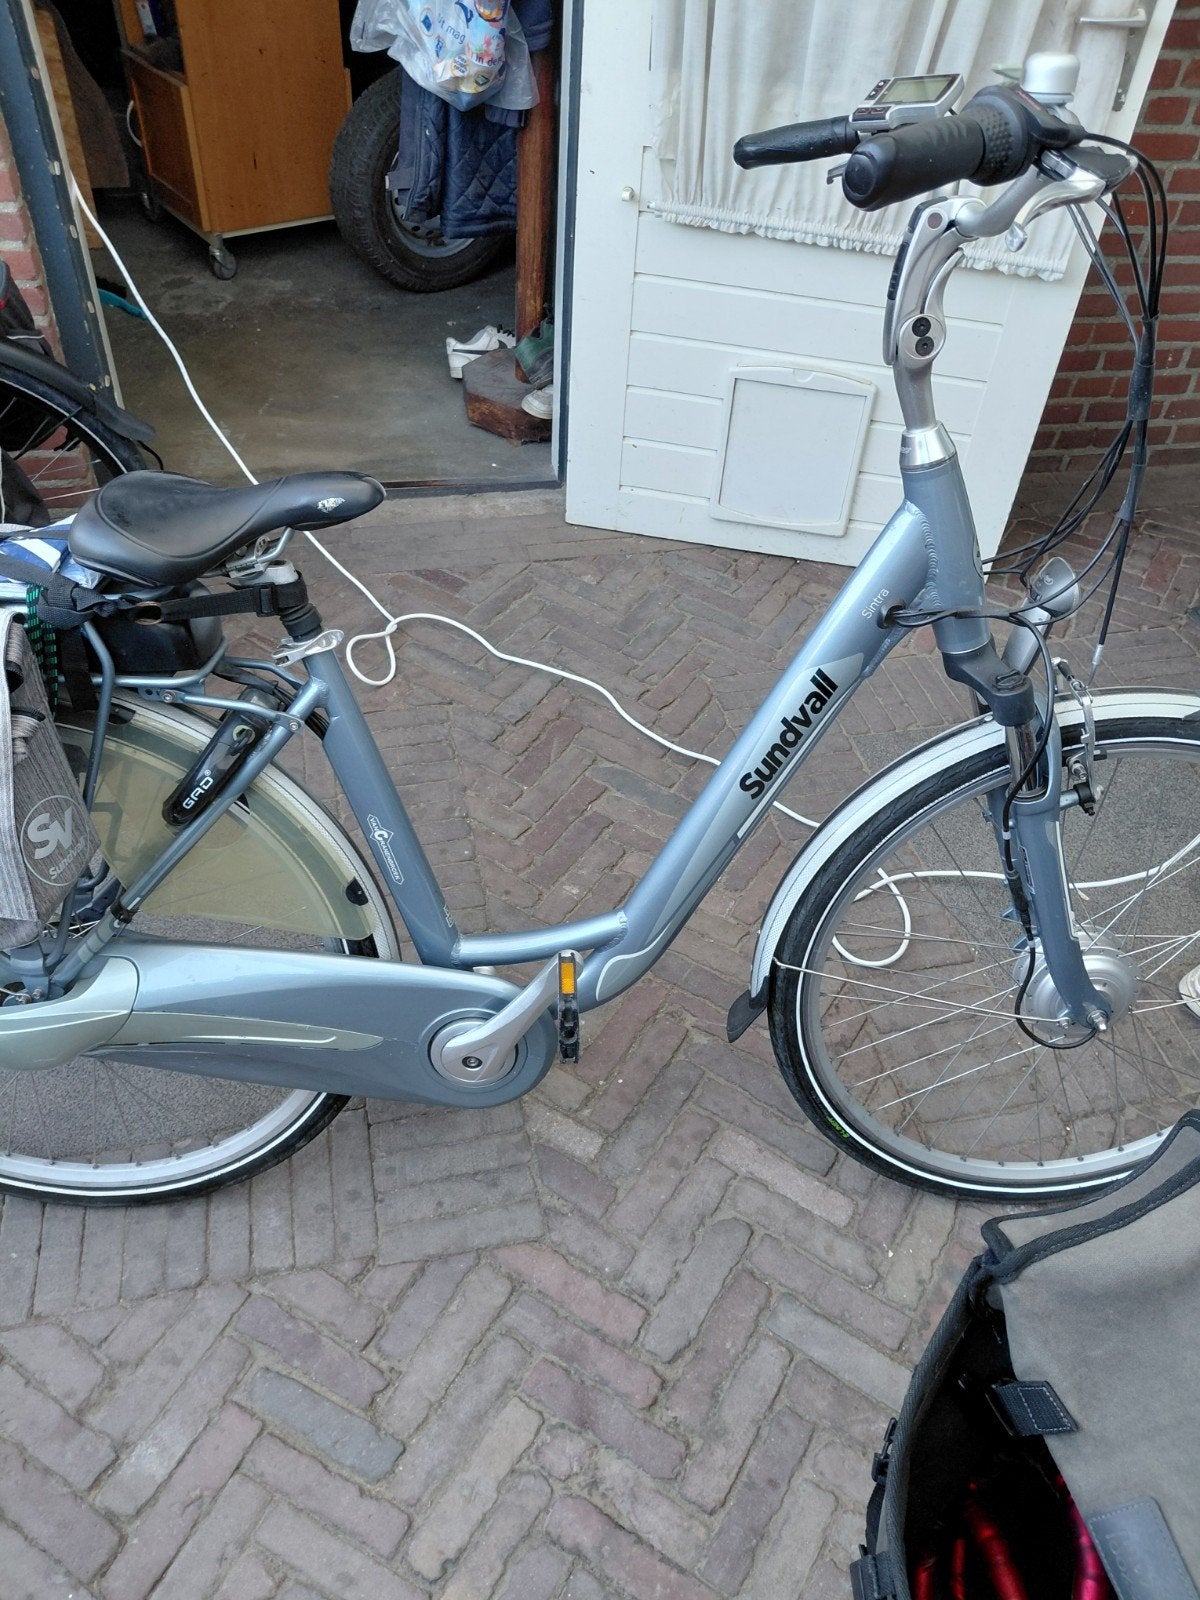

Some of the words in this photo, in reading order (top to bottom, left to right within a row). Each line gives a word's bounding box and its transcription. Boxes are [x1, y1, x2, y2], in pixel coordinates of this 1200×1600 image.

[446, 26, 466, 44] mag
[861, 588, 890, 619] Sintra
[739, 667, 839, 800] Sundvall
[182, 776, 214, 810] GAD
[27, 805, 73, 860] SV
[369, 817, 380, 832] VAN
[48, 835, 88, 880] Sundvall
